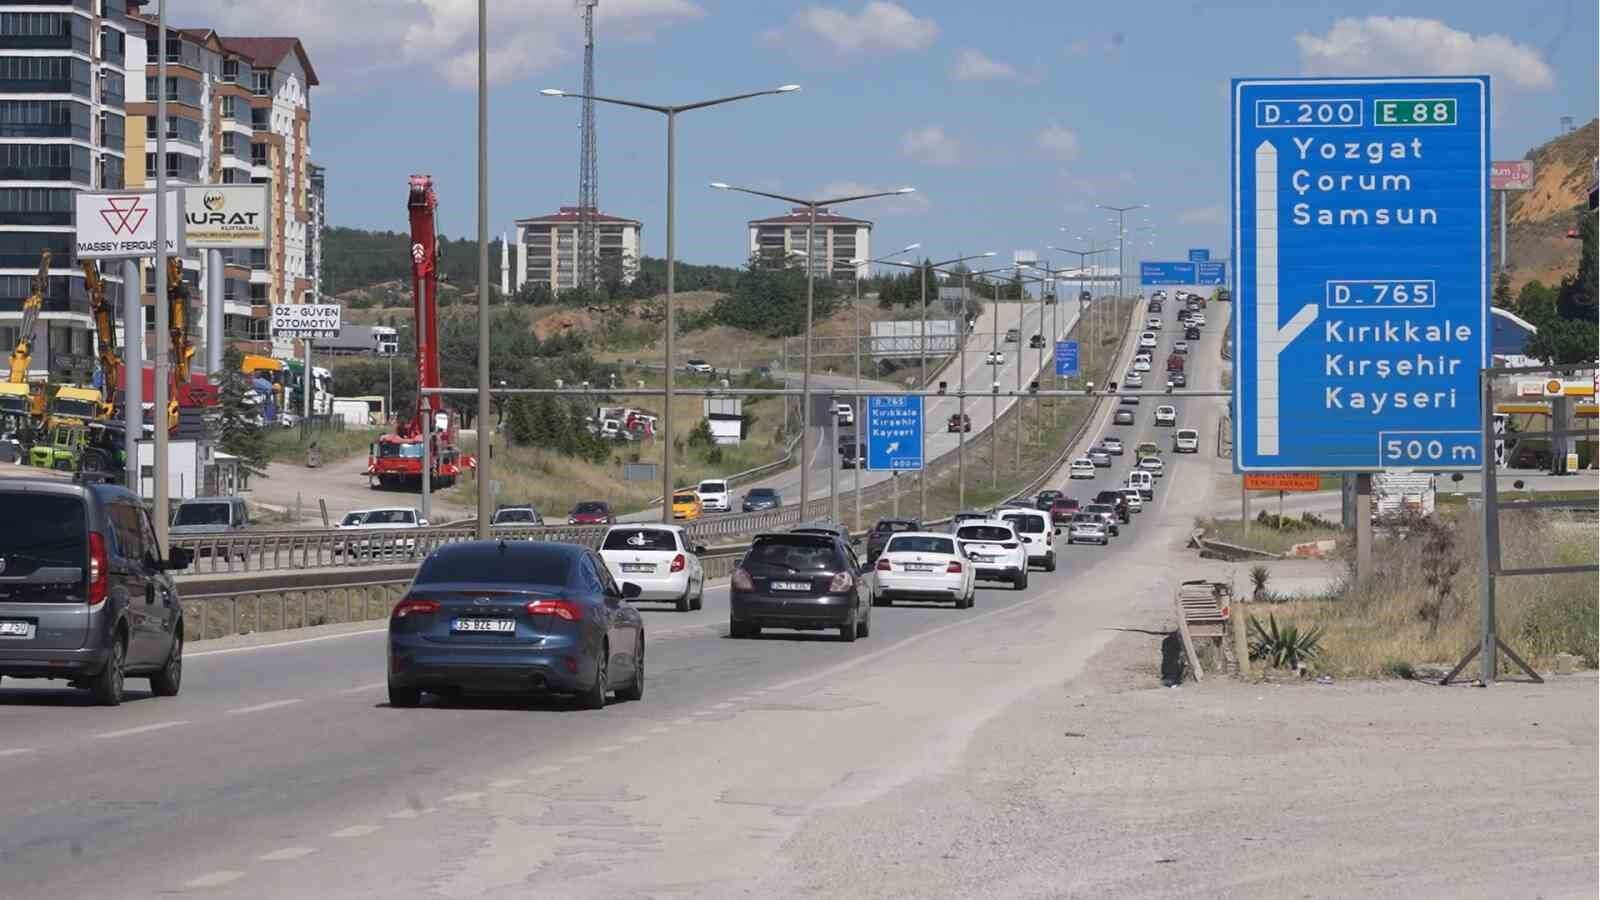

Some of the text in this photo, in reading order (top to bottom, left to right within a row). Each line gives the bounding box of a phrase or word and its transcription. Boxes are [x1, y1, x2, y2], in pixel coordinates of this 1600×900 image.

[1292, 136, 1423, 165] Yozgat
[1291, 168, 1411, 196] Çorum
[1292, 202, 1438, 226] Samsun
[78, 239, 174, 252] MASSEY FERGUSN
[300, 305, 339, 317] GÜVEN
[275, 317, 337, 328] OTOMOTİV
[1325, 319, 1472, 343] Kırıkkale
[1325, 353, 1462, 379] Kırşehir
[1325, 386, 1457, 415] Kayseri
[872, 409, 917, 417] Kırıkkale
[872, 428, 914, 438] Kayseri
[1386, 439, 1476, 459] 500 m
